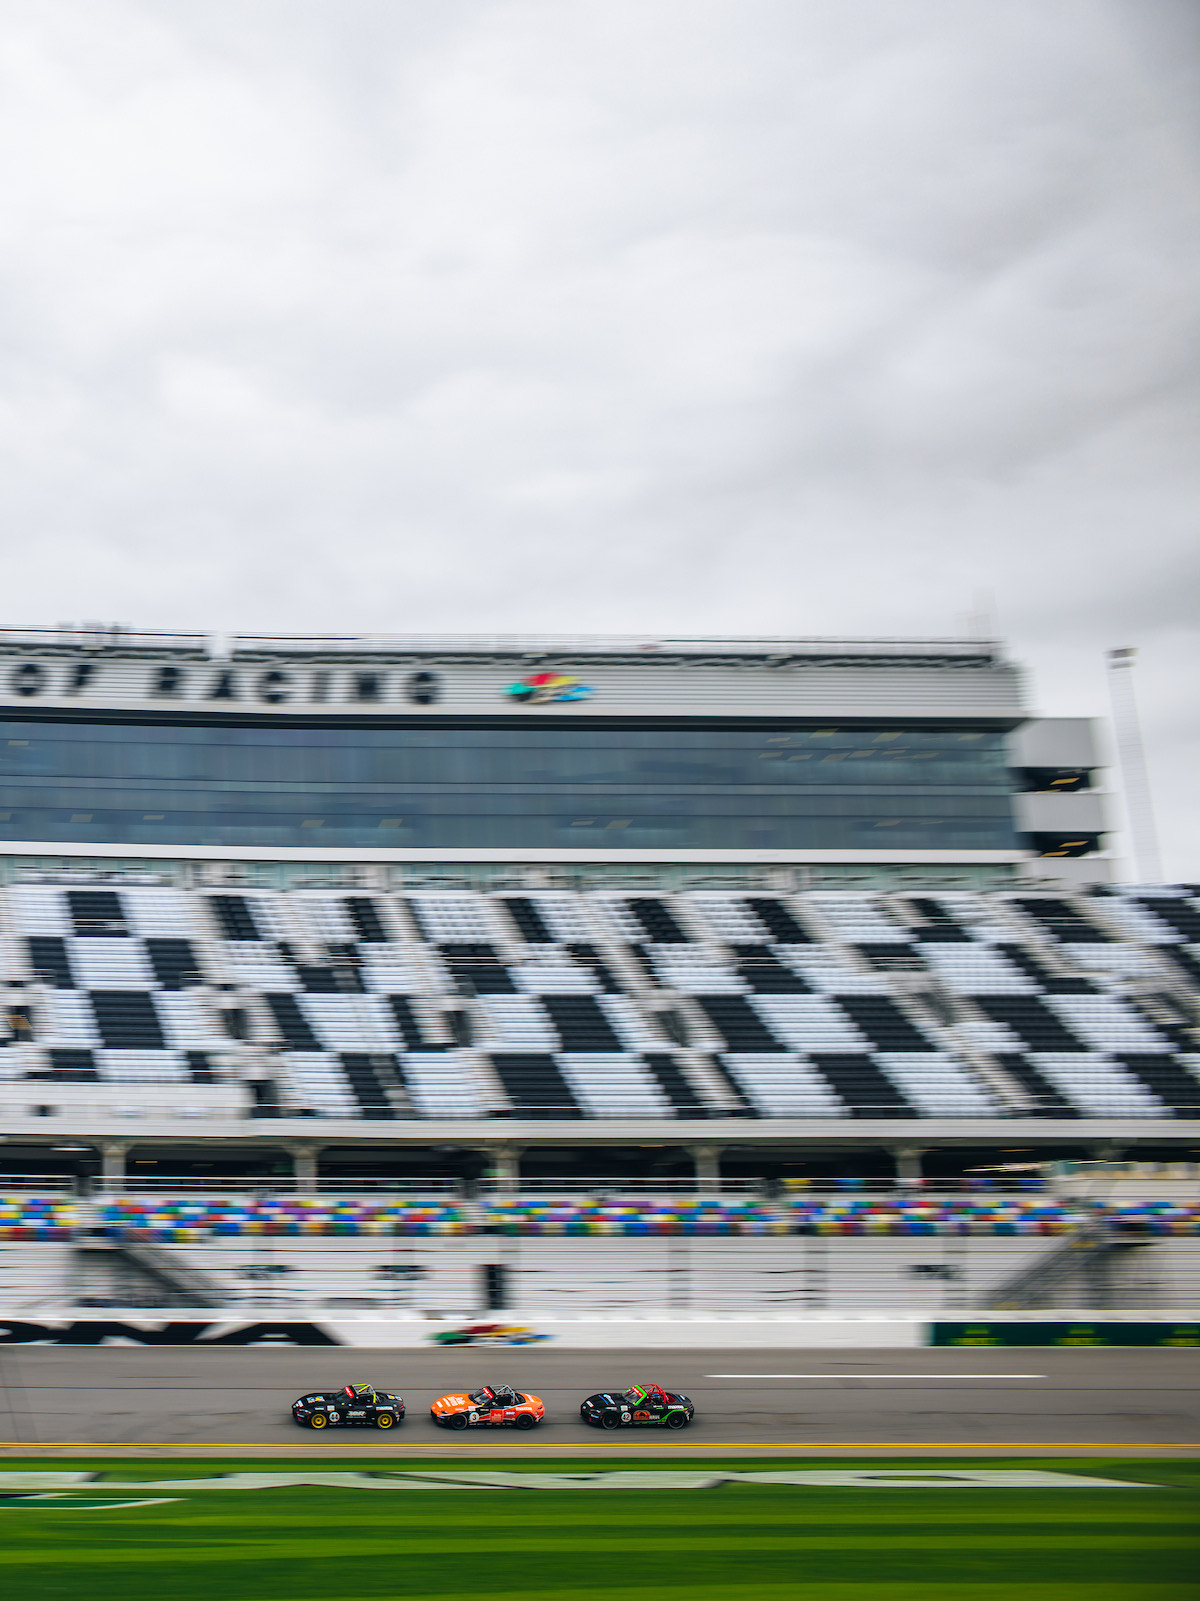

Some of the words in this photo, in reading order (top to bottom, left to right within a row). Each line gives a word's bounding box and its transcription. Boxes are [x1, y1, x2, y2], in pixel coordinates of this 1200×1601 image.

[12, 663, 98, 697] OF
[150, 667, 441, 704] RACING
[622, 1413, 630, 1421] 42
